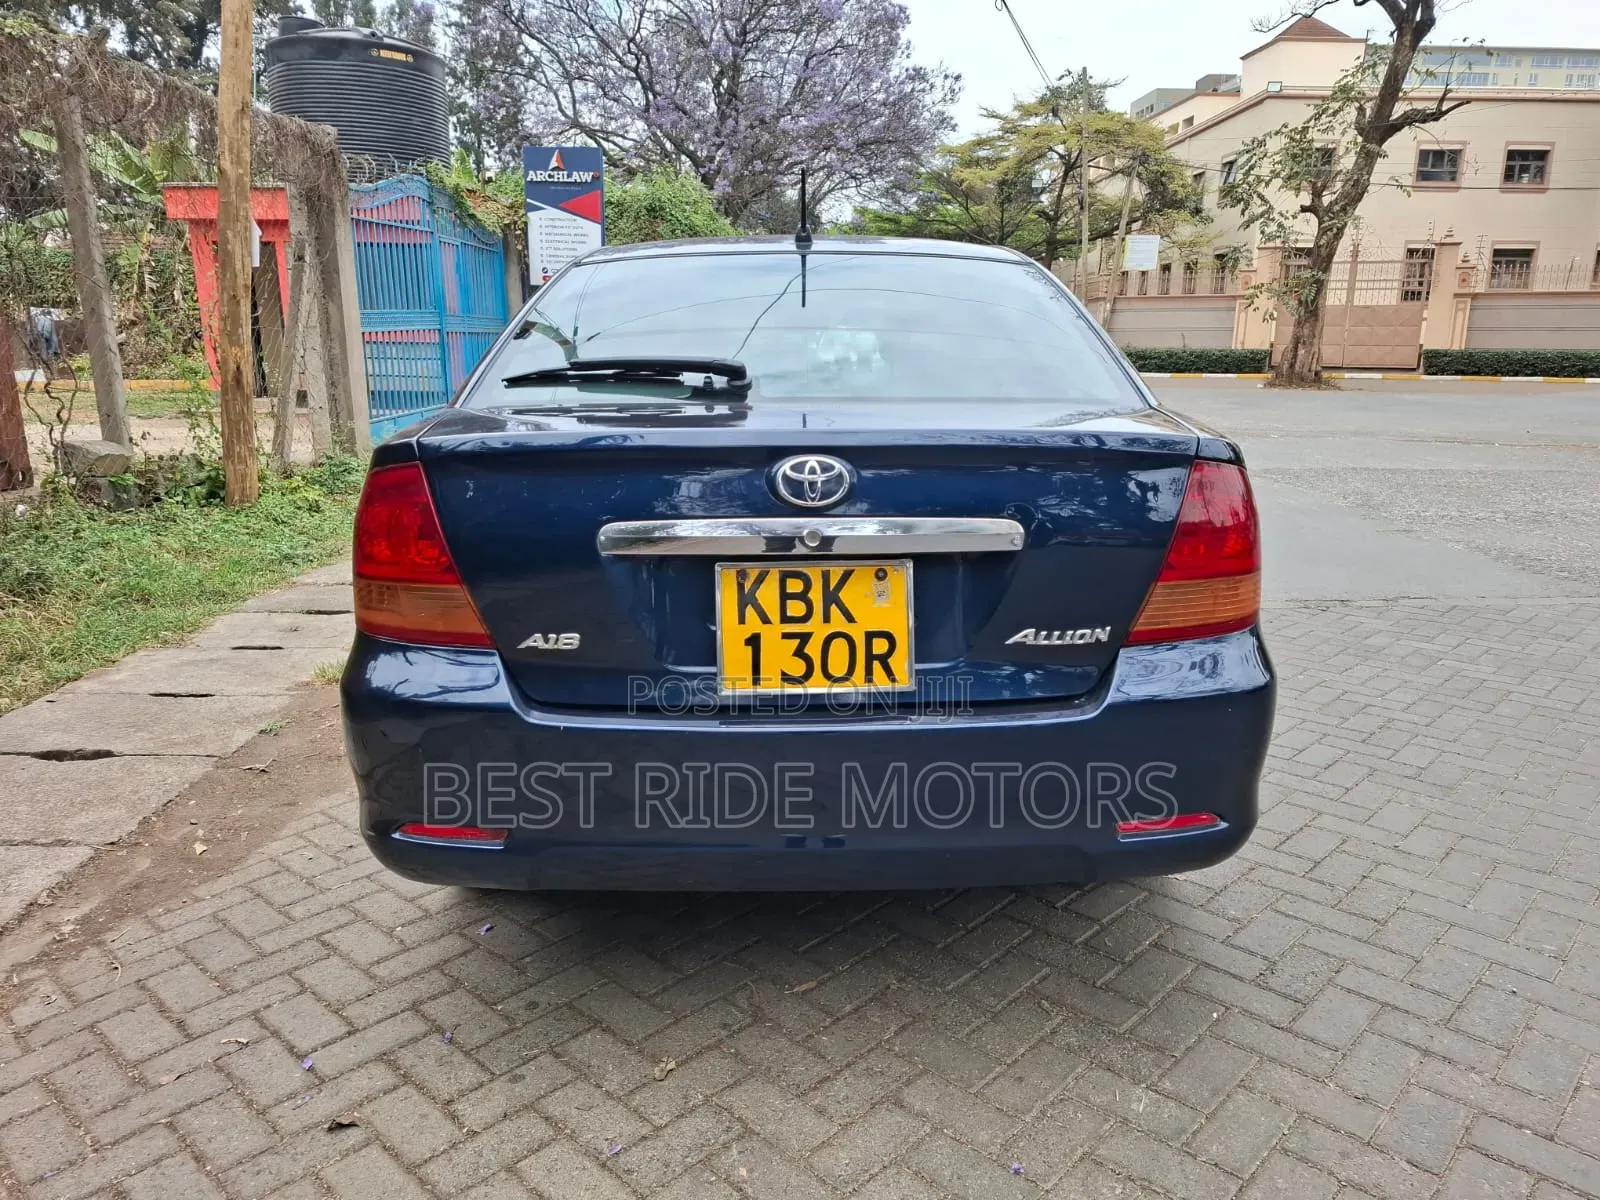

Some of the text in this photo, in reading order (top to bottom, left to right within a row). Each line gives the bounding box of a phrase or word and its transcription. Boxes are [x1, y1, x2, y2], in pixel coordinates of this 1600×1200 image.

[526, 170, 594, 183] ARCHLAW
[736, 568, 858, 626] KBK
[517, 633, 580, 649] A18
[1004, 626, 1112, 645] ALLION
[743, 630, 899, 687] 130R
